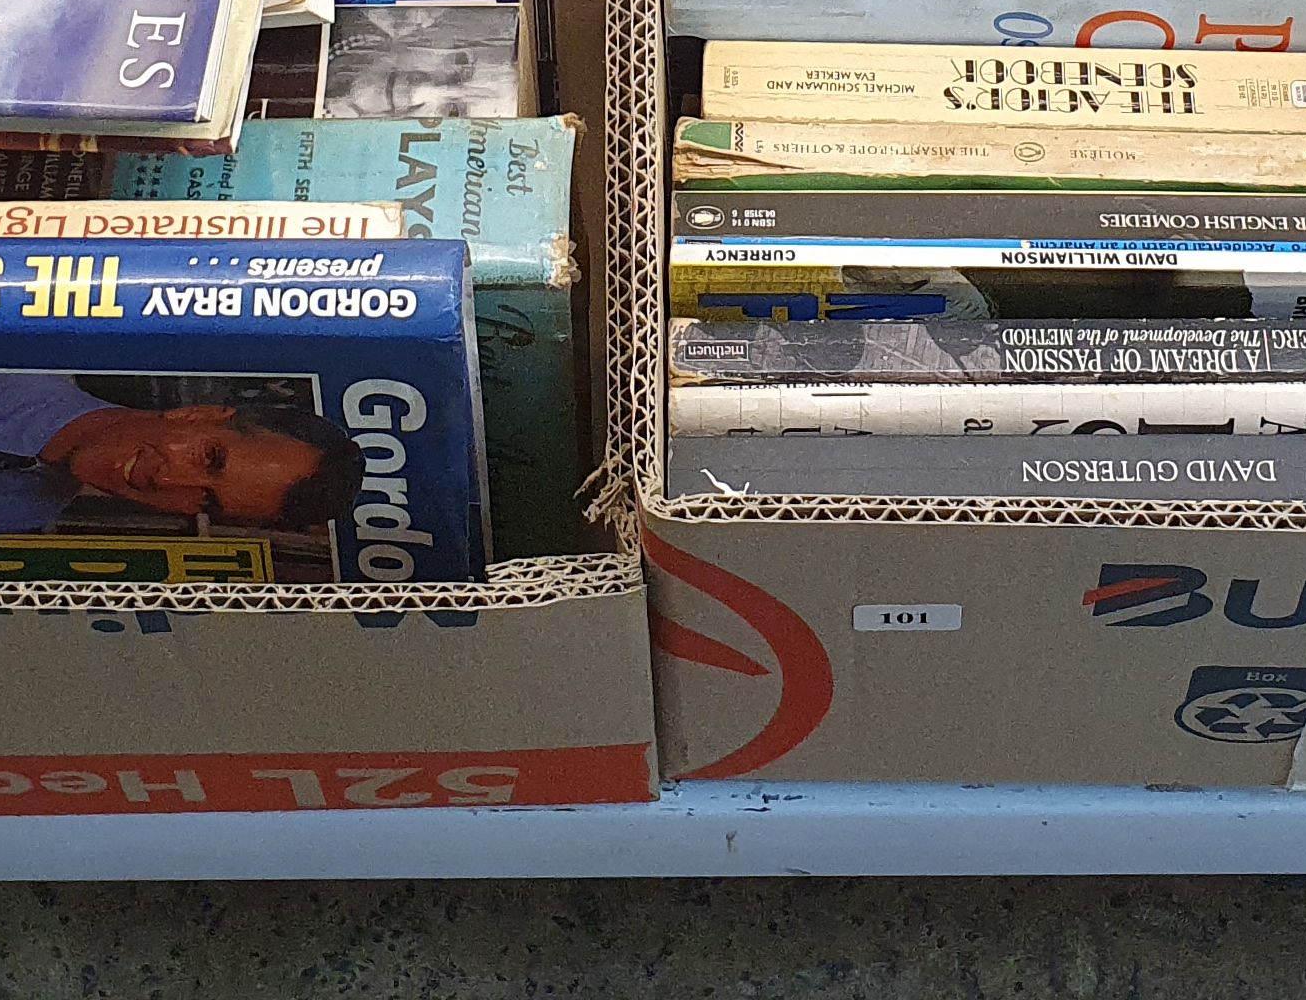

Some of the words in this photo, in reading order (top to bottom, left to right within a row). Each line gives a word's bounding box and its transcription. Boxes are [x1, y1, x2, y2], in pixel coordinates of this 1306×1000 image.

[806, 70, 851, 80] MEKLER
[854, 72, 876, 81] EVA
[949, 57, 1200, 90] SCENEBOOK
[767, 81, 792, 90] AND
[796, 81, 859, 92] SCHULMAN
[863, 83, 915, 93] MICHAEL
[1119, 90, 1204, 114] THE
[505, 137, 540, 197] Best
[84, 214, 286, 238] Illustrated
[304, 216, 370, 238] The
[1099, 213, 1199, 228] COMEDIES
[1205, 215, 1289, 230] ENGLISH
[249, 254, 384, 276] presents
[705, 250, 795, 261] CURRENCY
[142, 287, 242, 317] BRAY
[253, 287, 417, 318] GORDON
[1002, 328, 1073, 346] METHOD
[1077, 327, 1099, 345] the
[1123, 329, 1226, 348] Development
[1231, 329, 1260, 347] The
[687, 345, 745, 358] methuen
[1004, 348, 1107, 374] PASSION
[1111, 350, 1141, 372] OF
[1149, 350, 1238, 372] DREAM
[1022, 459, 1179, 482] GUTERSON
[1187, 460, 1277, 482] DAVID
[879, 611, 931, 626] 101
[1246, 671, 1289, 682] Box
[249, 766, 520, 806] 52L
